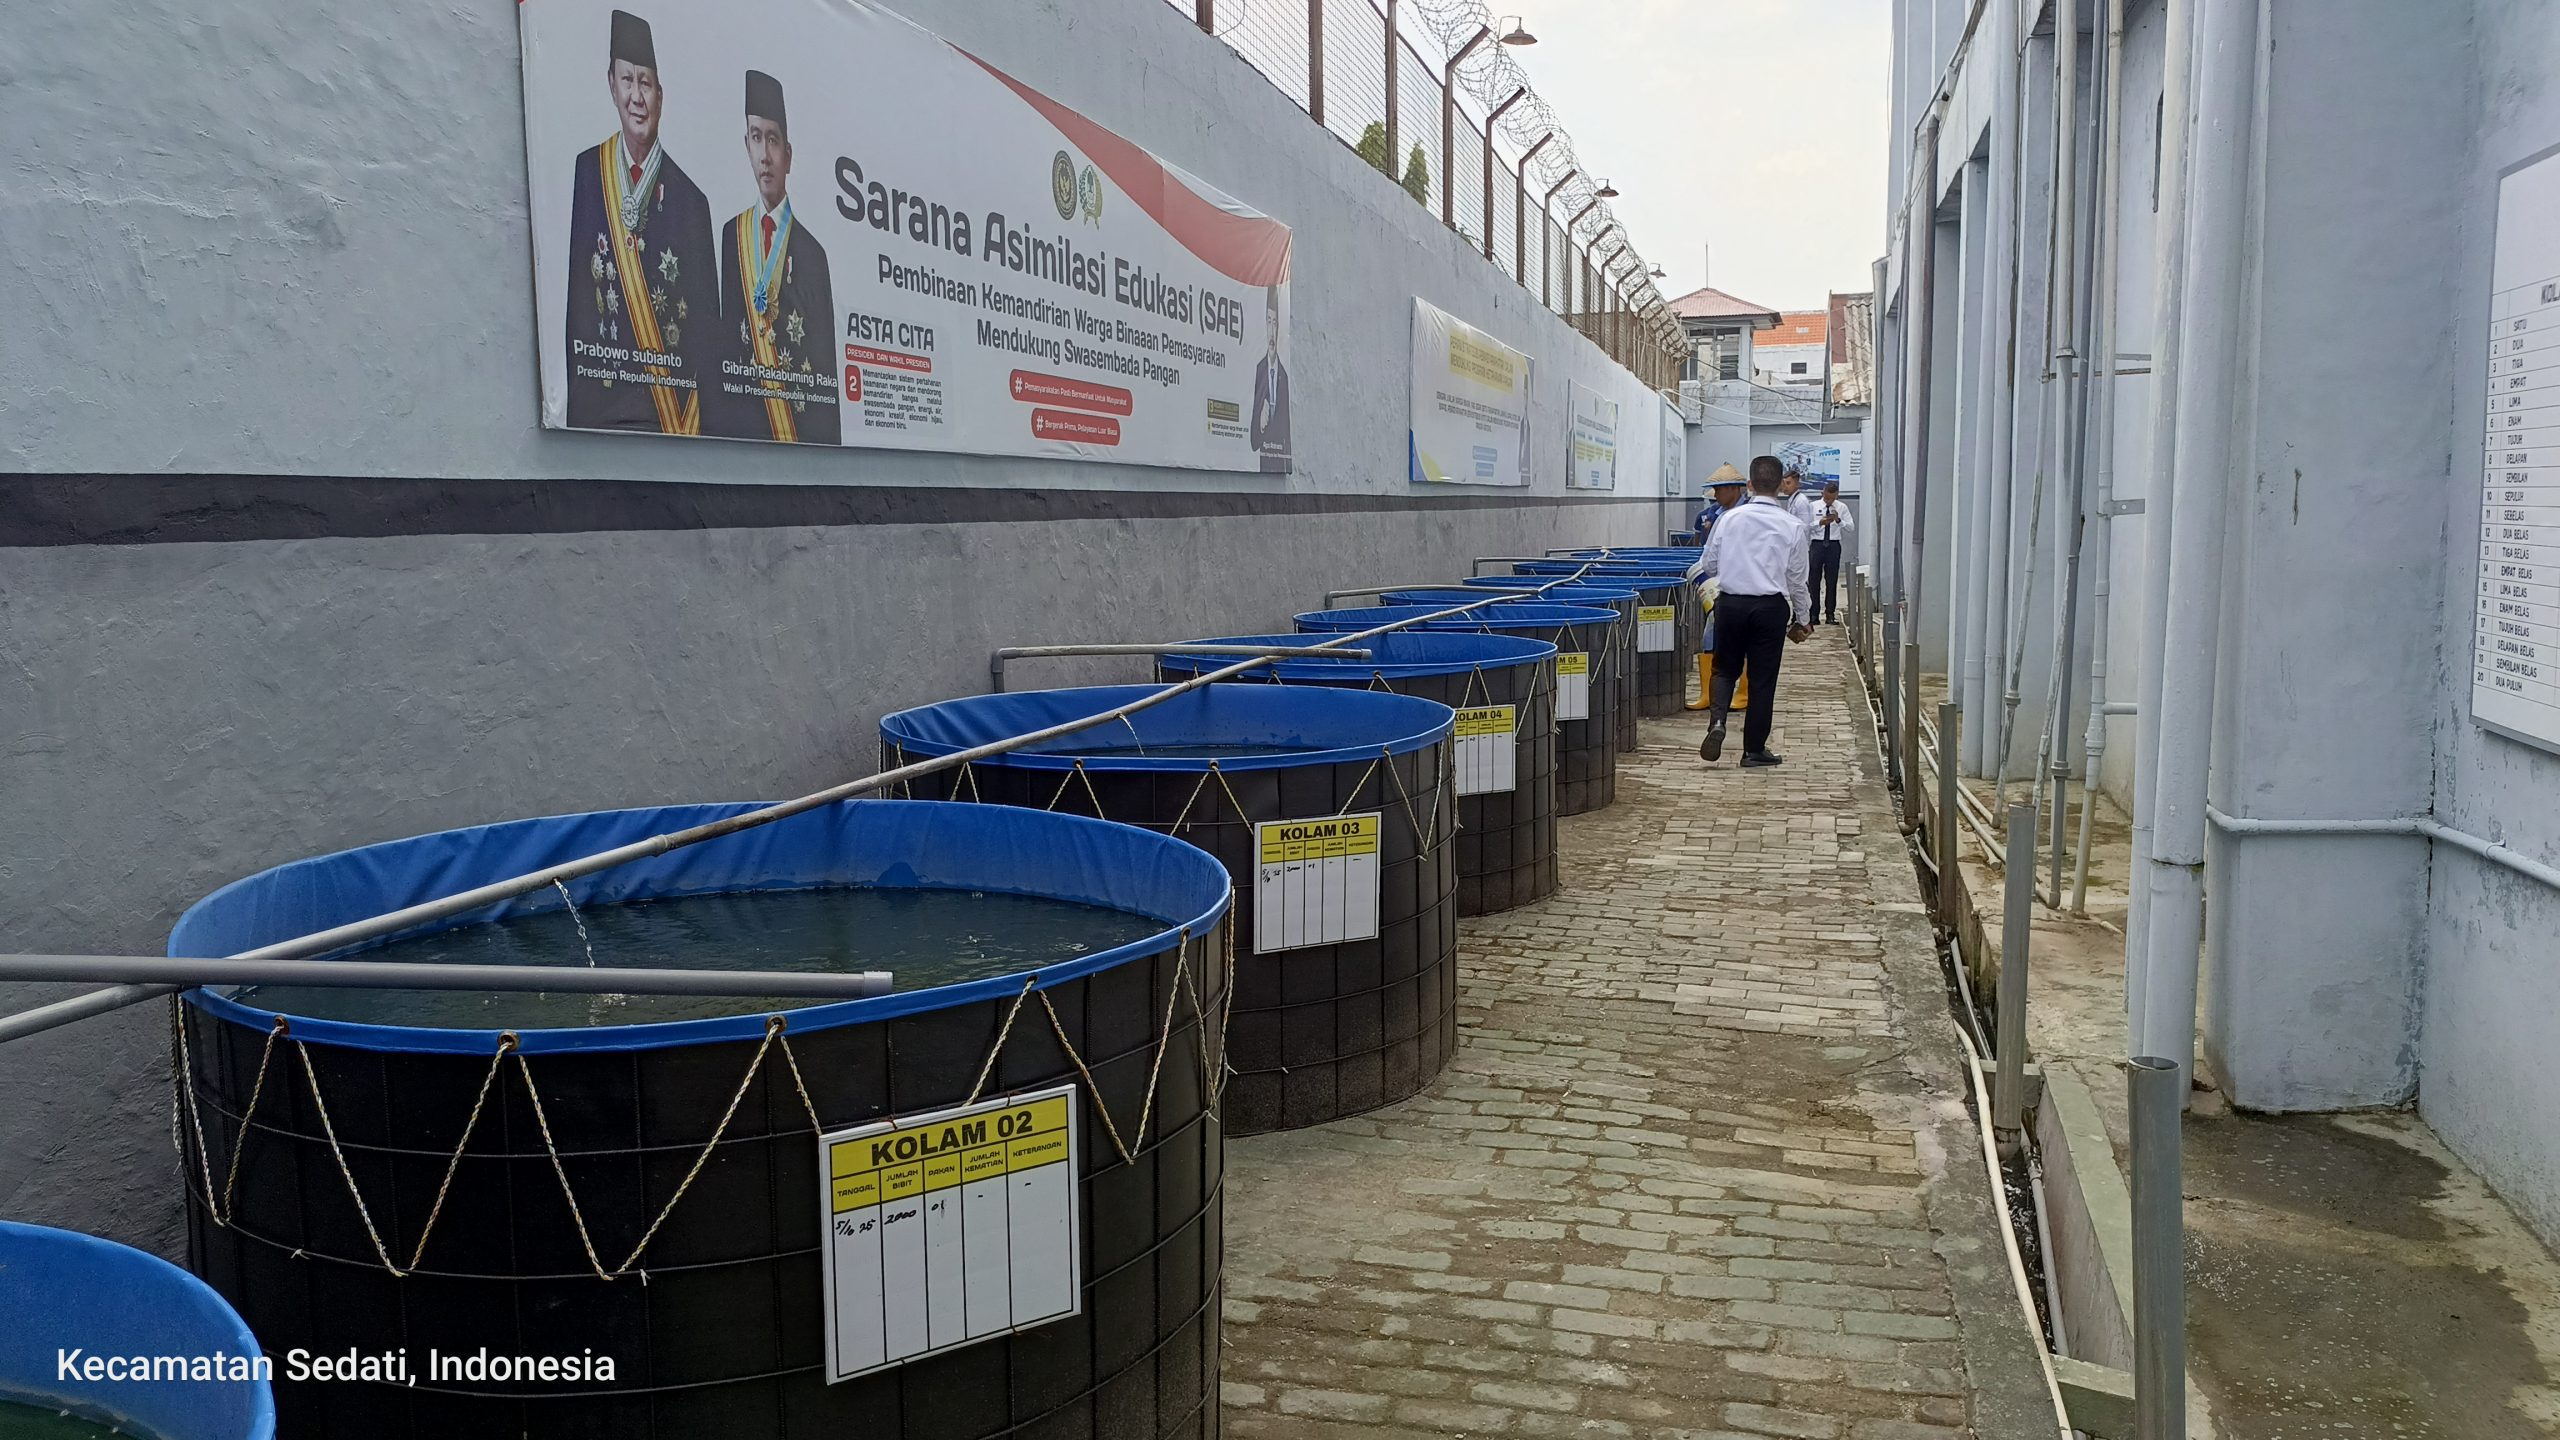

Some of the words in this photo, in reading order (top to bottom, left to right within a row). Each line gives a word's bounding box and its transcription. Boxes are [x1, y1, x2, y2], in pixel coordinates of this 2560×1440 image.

[835, 156, 971, 257] Sarana
[984, 212, 1106, 298] Asimilasi
[1115, 257, 1193, 324] Edukasi
[1199, 288, 1244, 346] (SAE)
[878, 253, 977, 307] Pembinaan
[982, 282, 1070, 329] Kemandirian
[1074, 308, 1112, 342] Warga
[1116, 320, 1159, 352] Binaaan
[1162, 333, 1226, 368] Pemasyarakan
[847, 312, 894, 344] ASTA
[898, 323, 934, 352] CITA
[977, 318, 1061, 366] Mendukung
[1064, 338, 1140, 377] Swasembada
[1143, 358, 1180, 387] Pangan
[2494, 344, 2498, 354] 2
[2512, 338, 2523, 350] DUA
[574, 339, 629, 361] Prabowo
[632, 350, 682, 368] subianto
[847, 348, 875, 360] PRESIDEN
[876, 353, 888, 362] DAN
[889, 354, 905, 365] WAKIL
[906, 358, 930, 368] PRESIDEN
[2493, 362, 2496, 372] 3
[2512, 358, 2523, 370] TIGA
[577, 365, 618, 380] Presiden
[620, 370, 656, 384] Republik
[658, 374, 698, 388] Indonesia
[722, 360, 755, 377] Gibran
[758, 366, 814, 388] Rakabuming
[816, 374, 838, 388] Raka
[863, 368, 897, 381] Memantapkan
[849, 376, 858, 392] 2
[890, 384, 906, 392] negara
[907, 385, 916, 393] dan
[1024, 382, 1060, 395] Pemasyarakatan
[2510, 376, 2526, 389] EMPAT
[723, 382, 743, 394] Wakil
[744, 385, 777, 398] Presiden
[777, 388, 806, 401] Republik
[806, 393, 836, 404] Indonesia
[864, 388, 894, 400] kemandirian
[864, 400, 896, 410] swasembada
[2491, 399, 2494, 410] 5
[2508, 396, 2520, 408] LIMA
[865, 418, 874, 426] dan
[2490, 418, 2494, 428] 6
[2508, 416, 2522, 426] ENAM
[1098, 426, 1106, 434] Luar
[2490, 436, 2493, 446] 7
[2508, 434, 2522, 446] TUJUH
[2488, 454, 2492, 464] 8
[2506, 453, 2528, 464] DELAPAN
[2488, 472, 2492, 482] 9
[2506, 472, 2528, 483] SEMBILAN
[2487, 491, 2492, 500] 10
[2504, 492, 2524, 502] SEPULUH
[2486, 509, 2490, 519] 11
[2504, 510, 2524, 521] SEBELAS
[2486, 527, 2490, 538] 12
[2503, 528, 2512, 539] DUA
[2514, 529, 2529, 540] BELAS
[2484, 545, 2489, 556] 13
[2502, 546, 2513, 558] TIGA
[2514, 548, 2530, 560] BELAS
[2501, 566, 2516, 576] EMPAT
[2518, 568, 2532, 580] BELAS
[2500, 584, 2511, 595] LIMA
[2513, 586, 2528, 598] BELAS
[2500, 602, 2514, 614] ENAM
[2514, 605, 2530, 618] BELAS
[2498, 621, 2514, 634] TUJUH
[2514, 624, 2530, 637] BELAS
[2498, 639, 2518, 654] DELAPAN
[2520, 644, 2534, 658] BELAS
[1568, 656, 1578, 664] 05
[2496, 658, 2520, 674] SEMBILAN
[2521, 664, 2537, 678] BELAS
[2478, 672, 2484, 682] 20
[2496, 676, 2505, 688] DUA
[2506, 678, 2522, 692] PULUH
[1490, 710, 1502, 718] 04
[1280, 824, 1336, 840] KOLAM
[1342, 822, 1360, 834] 03
[871, 1120, 987, 1167] KOLAM
[997, 1110, 1033, 1138] 02
[1012, 1140, 1062, 1158] KETERANGAN
[969, 1150, 1001, 1164] JUMLAH
[928, 1164, 956, 1177] PAKAN
[964, 1158, 1004, 1174] KEMATIAN
[885, 1168, 919, 1182] JUMLAH
[837, 1183, 876, 1198] TANGGAL
[892, 1180, 913, 1190] BIBIT
[884, 1210, 917, 1225] 2000
